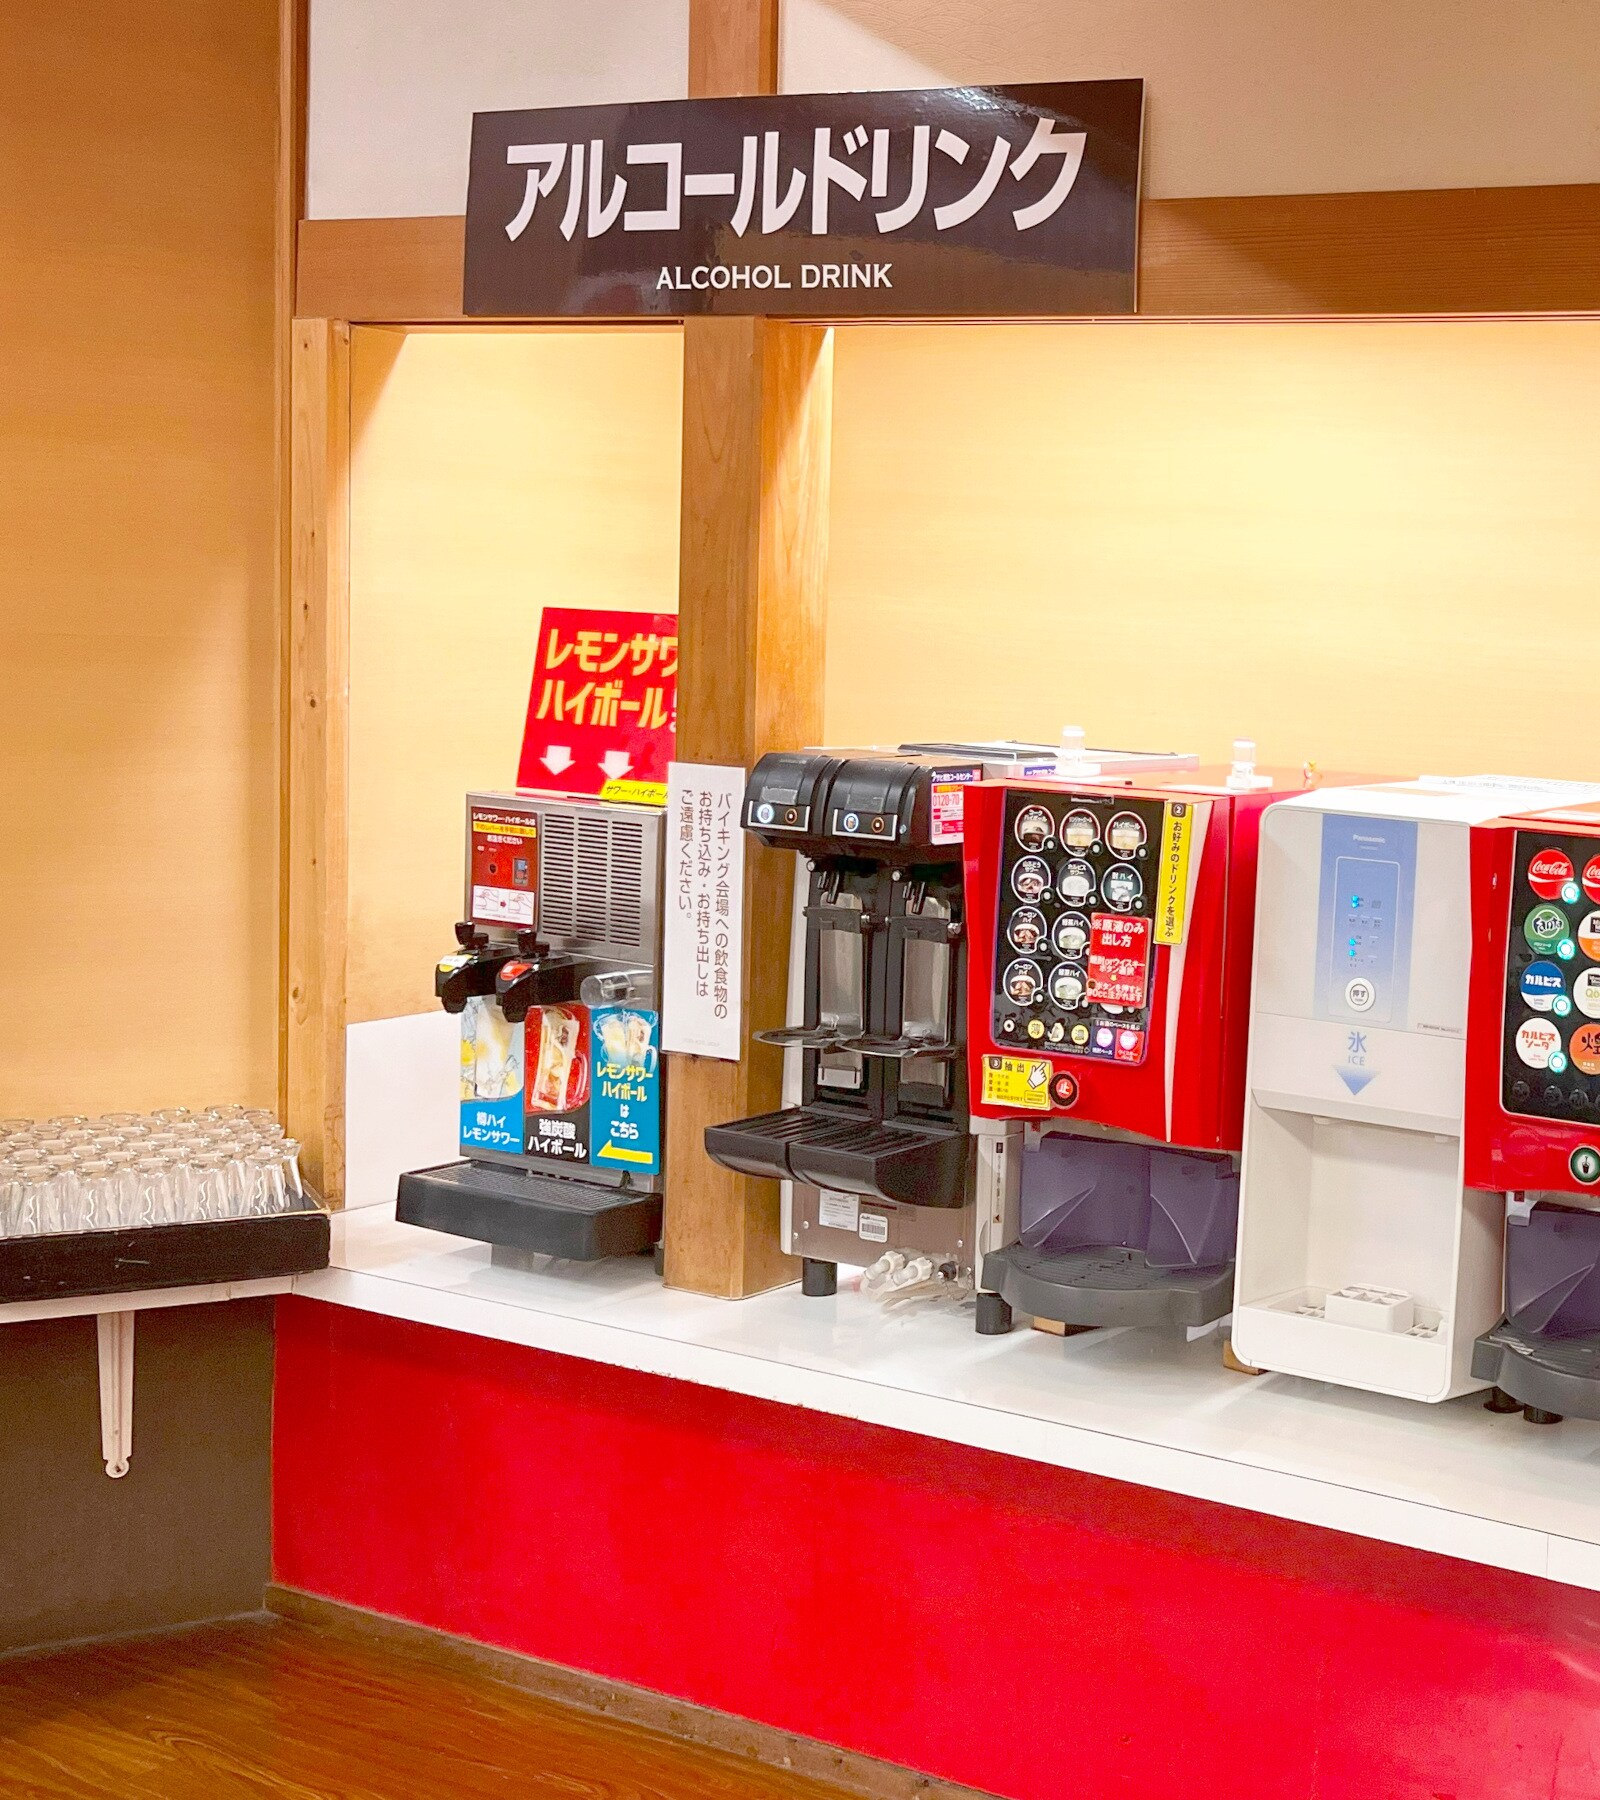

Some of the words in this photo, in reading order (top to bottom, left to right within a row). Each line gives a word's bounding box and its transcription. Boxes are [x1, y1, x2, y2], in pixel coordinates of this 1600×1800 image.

[504, 118, 1088, 242] アルコールドリンク
[656, 264, 792, 290] ALCOHOL
[801, 262, 893, 290] DRINK
[535, 681, 668, 730] ハイボール
[677, 788, 694, 919] ご遠慮ください。
[695, 790, 713, 998] お持ち込み・お持ち出しは
[713, 792, 732, 1020] バイキング会場への飲食物の
[1101, 933, 1132, 948] 出し方
[1525, 973, 1562, 988] カルピス
[1347, 1031, 1367, 1053] 氷
[1521, 1029, 1556, 1043] カルピス
[1525, 1040, 1551, 1050] ソーダ
[1348, 1055, 1365, 1067] ICE
[596, 1062, 654, 1083] レモンサワー
[602, 1082, 648, 1103] ハイボール
[476, 1111, 507, 1127] 樽ハイ
[620, 1104, 629, 1118] は
[463, 1126, 520, 1144] レモンサワー
[538, 1118, 576, 1139] 強炭酸
[609, 1120, 640, 1140] こちら
[528, 1136, 588, 1159] ハイボール
